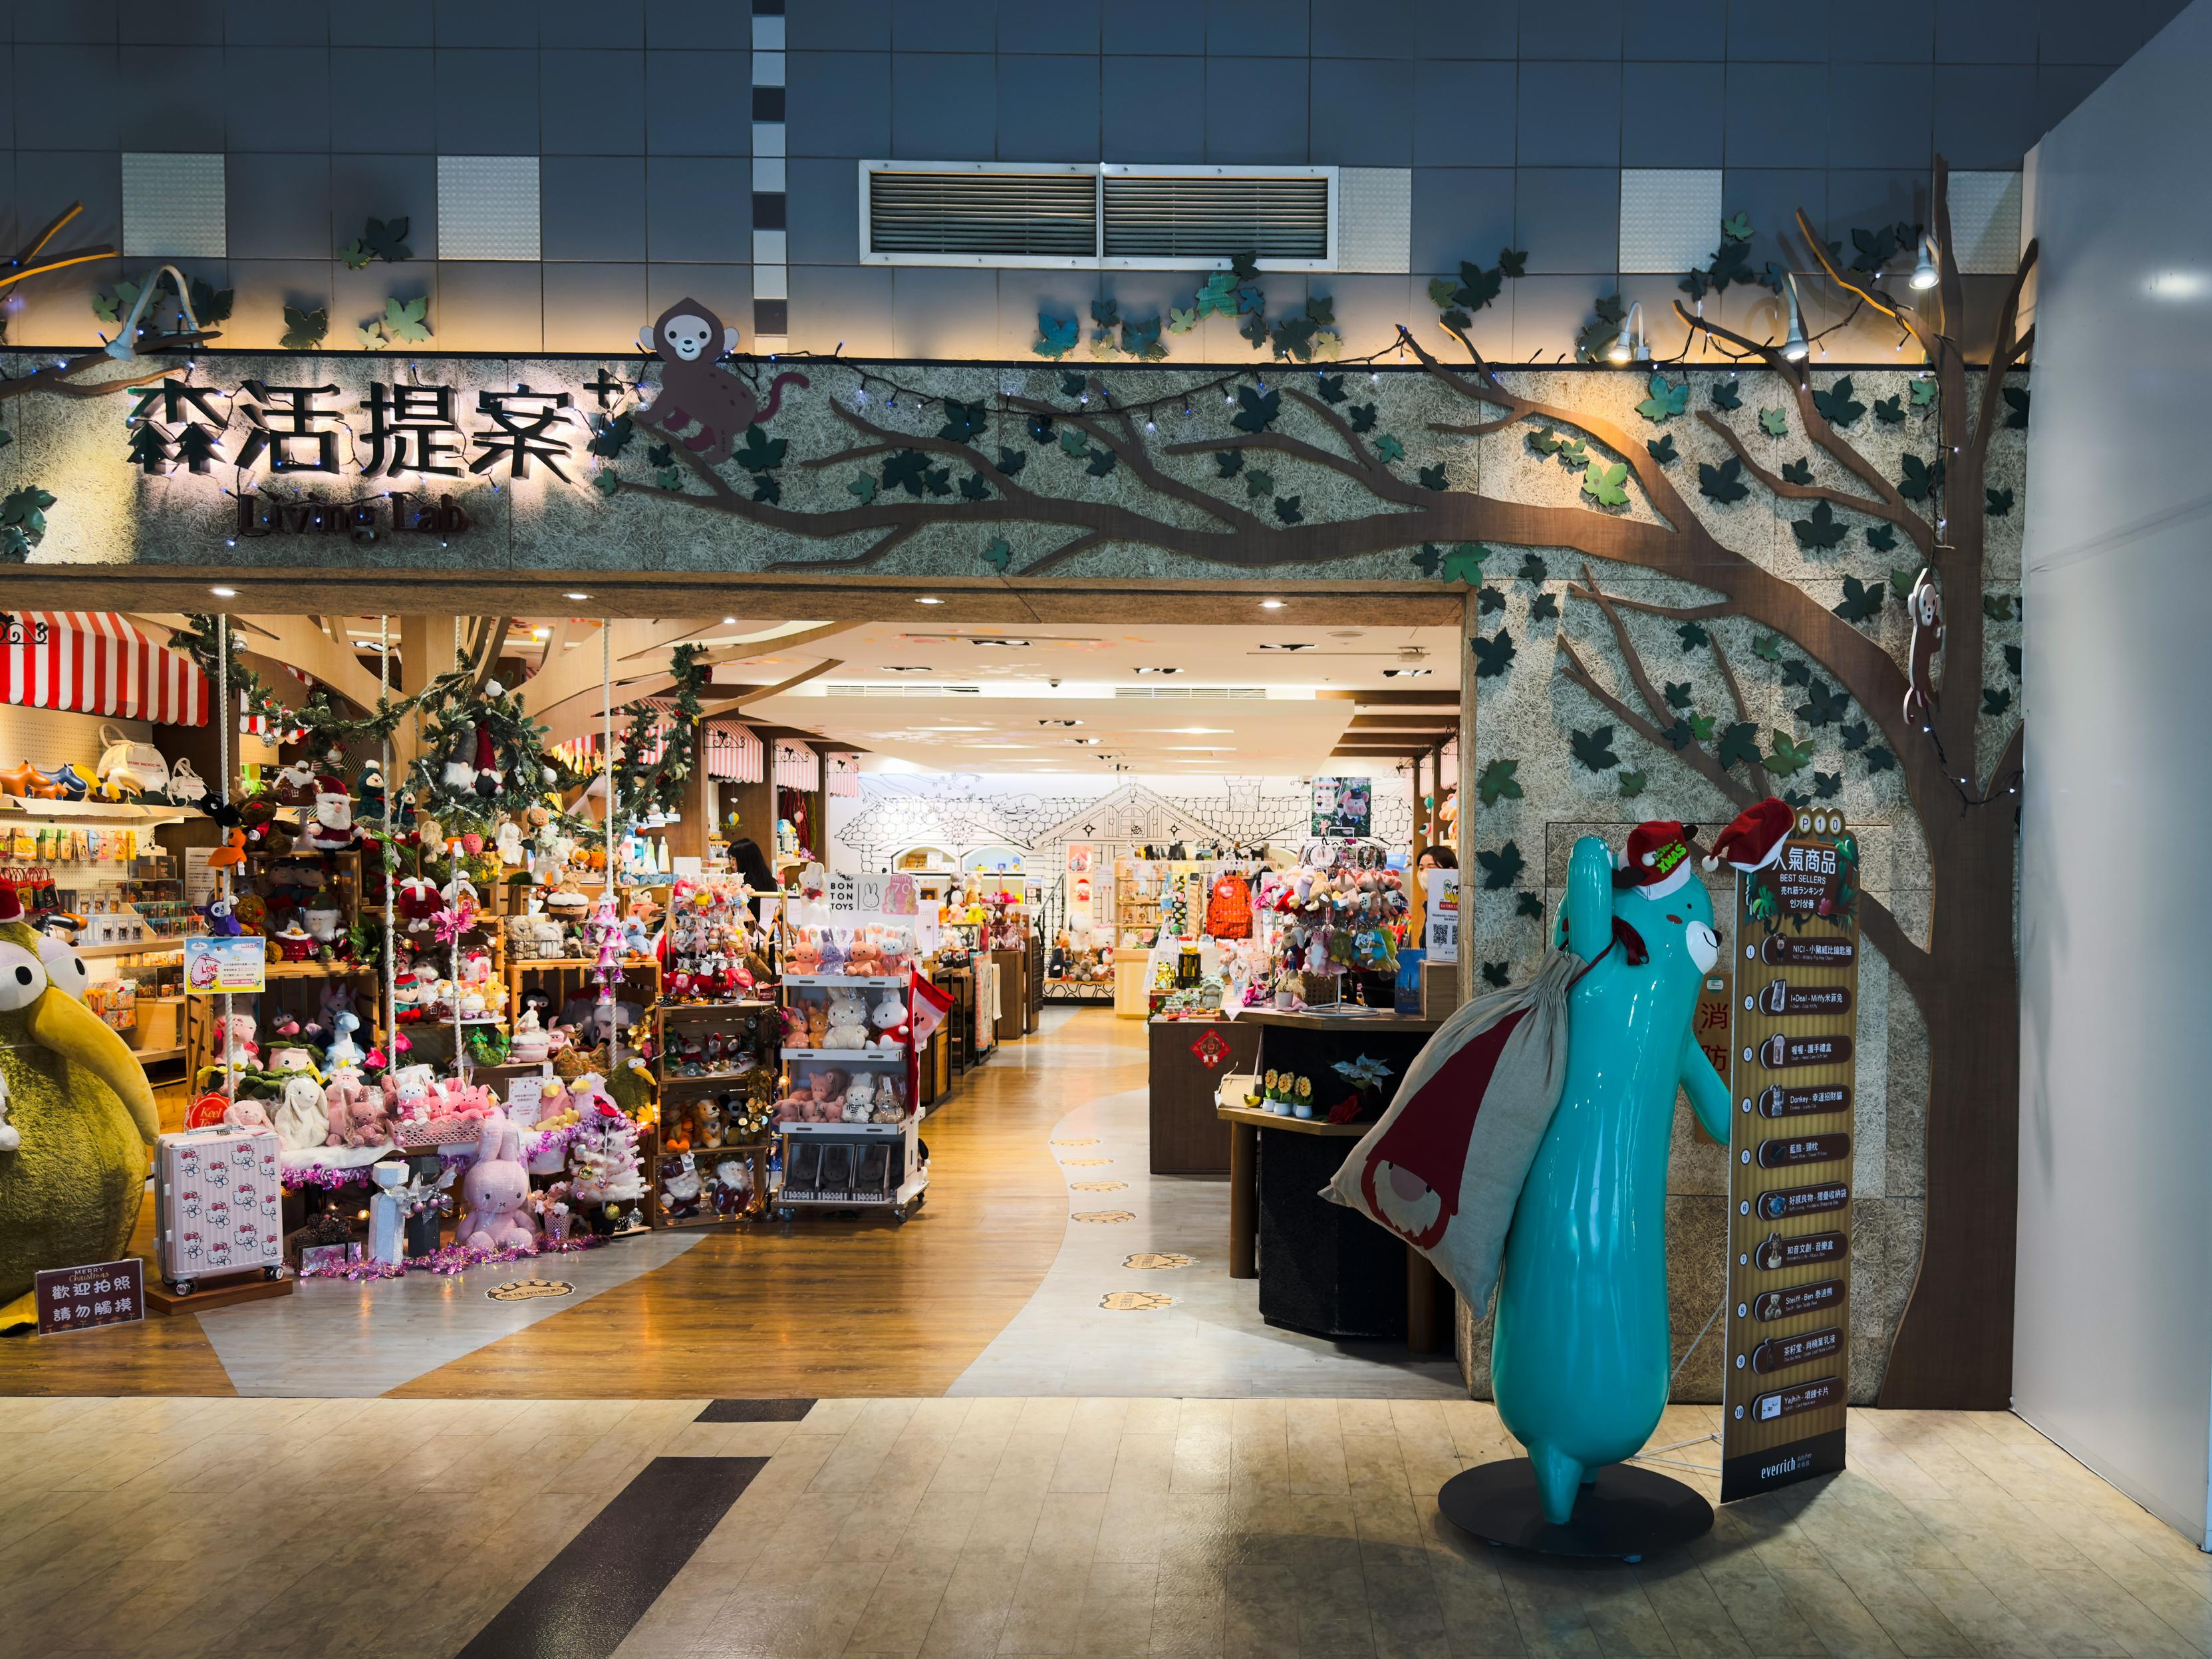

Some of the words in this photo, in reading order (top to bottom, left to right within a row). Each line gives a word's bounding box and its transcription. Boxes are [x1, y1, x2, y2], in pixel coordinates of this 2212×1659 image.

[238, 492, 382, 545] Living
[392, 492, 471, 535] Lab
[1771, 846, 1836, 875] 人氣商品
[891, 875, 912, 883] miffy
[1780, 874, 1796, 883] BEST
[1798, 874, 1827, 885] SELLERS
[891, 883, 911, 895] 70
[1780, 885, 1825, 896] 売れ筋ランキング
[1790, 899, 1815, 909] 인기상품
[1793, 945, 1806, 954] NICI
[201, 964, 219, 975] LOVE
[1790, 1096, 1809, 1105] Donkey
[201, 1107, 222, 1118] Keel
[1787, 1243, 1812, 1256] 知音文創
[1815, 1240, 1834, 1252] 音樂盒
[74, 1266, 104, 1275] MERRY
[69, 1271, 110, 1283] Christmas
[52, 1275, 132, 1301] 歡迎拍照
[1786, 1294, 1801, 1305] Steiff
[1815, 1287, 1833, 1299] 泰迪熊
[53, 1297, 133, 1322] 請勿觸摸
[1740, 1306, 1744, 1315] 8
[1784, 1344, 1802, 1356] 茶籽堂
[1738, 1357, 1743, 1366] 9
[1784, 1394, 1802, 1405] Yajhih
[1760, 1457, 1796, 1479] everrich
